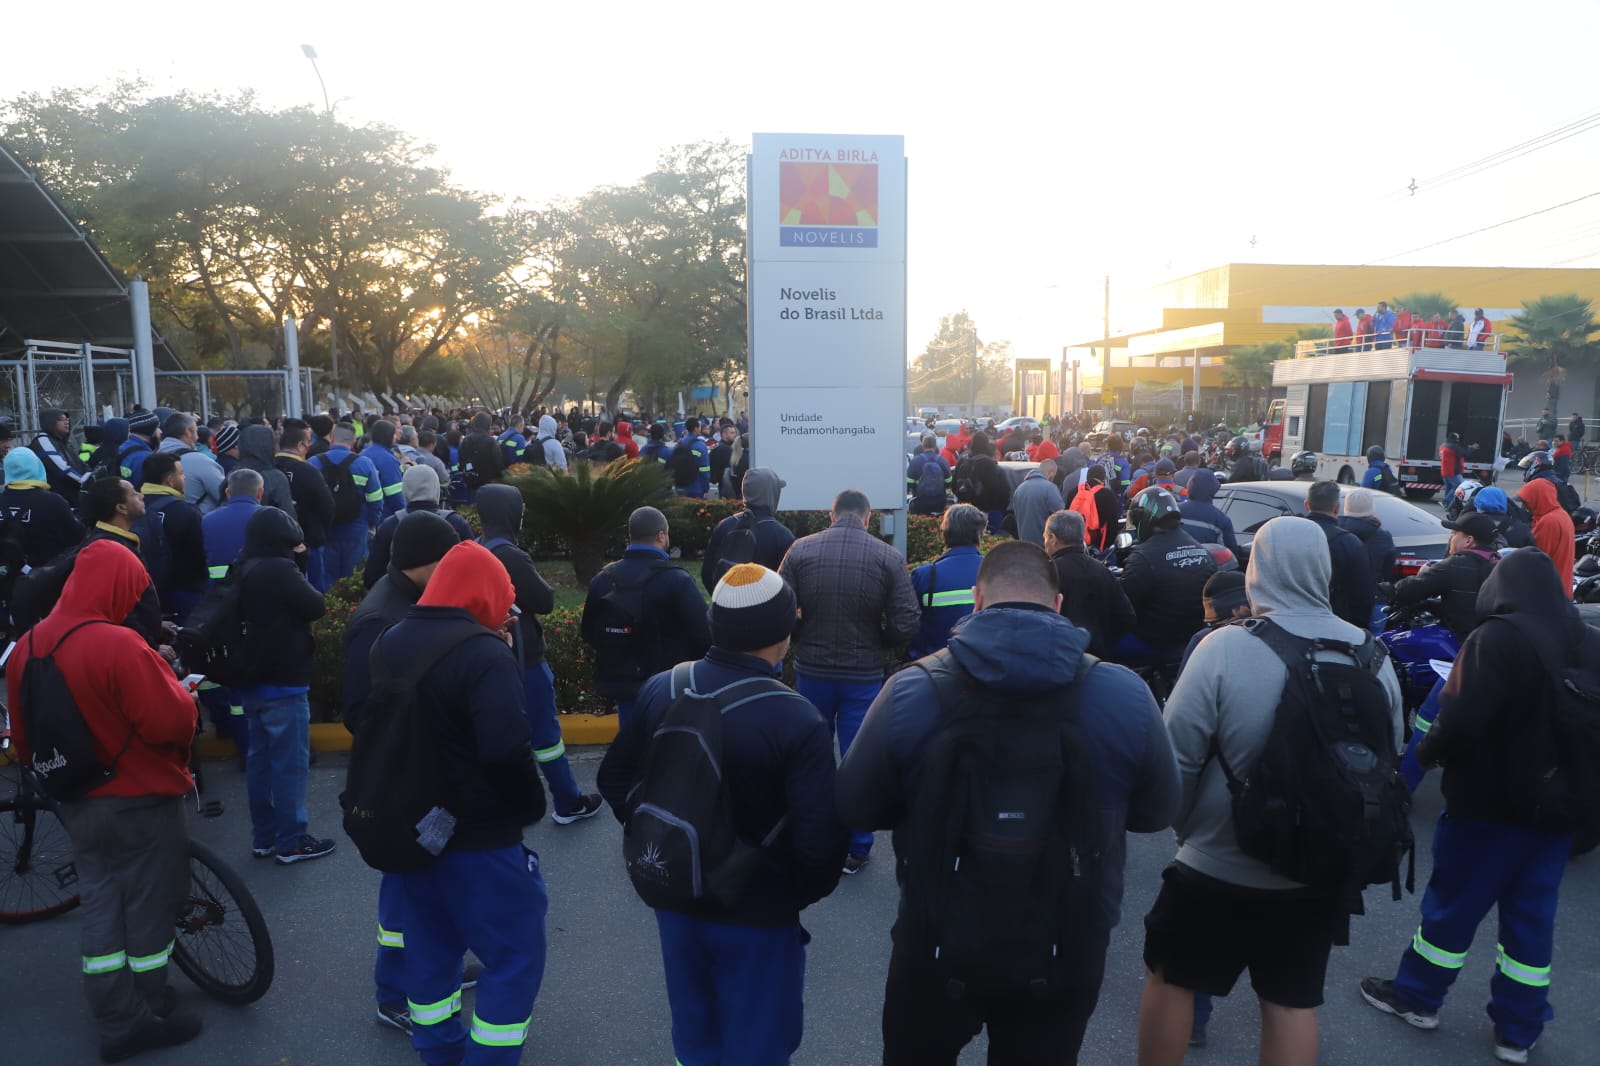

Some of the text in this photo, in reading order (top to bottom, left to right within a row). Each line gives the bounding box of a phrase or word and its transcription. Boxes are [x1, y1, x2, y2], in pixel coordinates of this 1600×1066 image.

[780, 148, 878, 162] ADITYA BIRLA
[793, 231, 865, 244] NOVELIS
[780, 287, 837, 301] Novelis
[780, 307, 884, 320] do Brasil Ltda
[780, 413, 823, 422] Unidade
[780, 425, 876, 437] Pindamonhangaba
